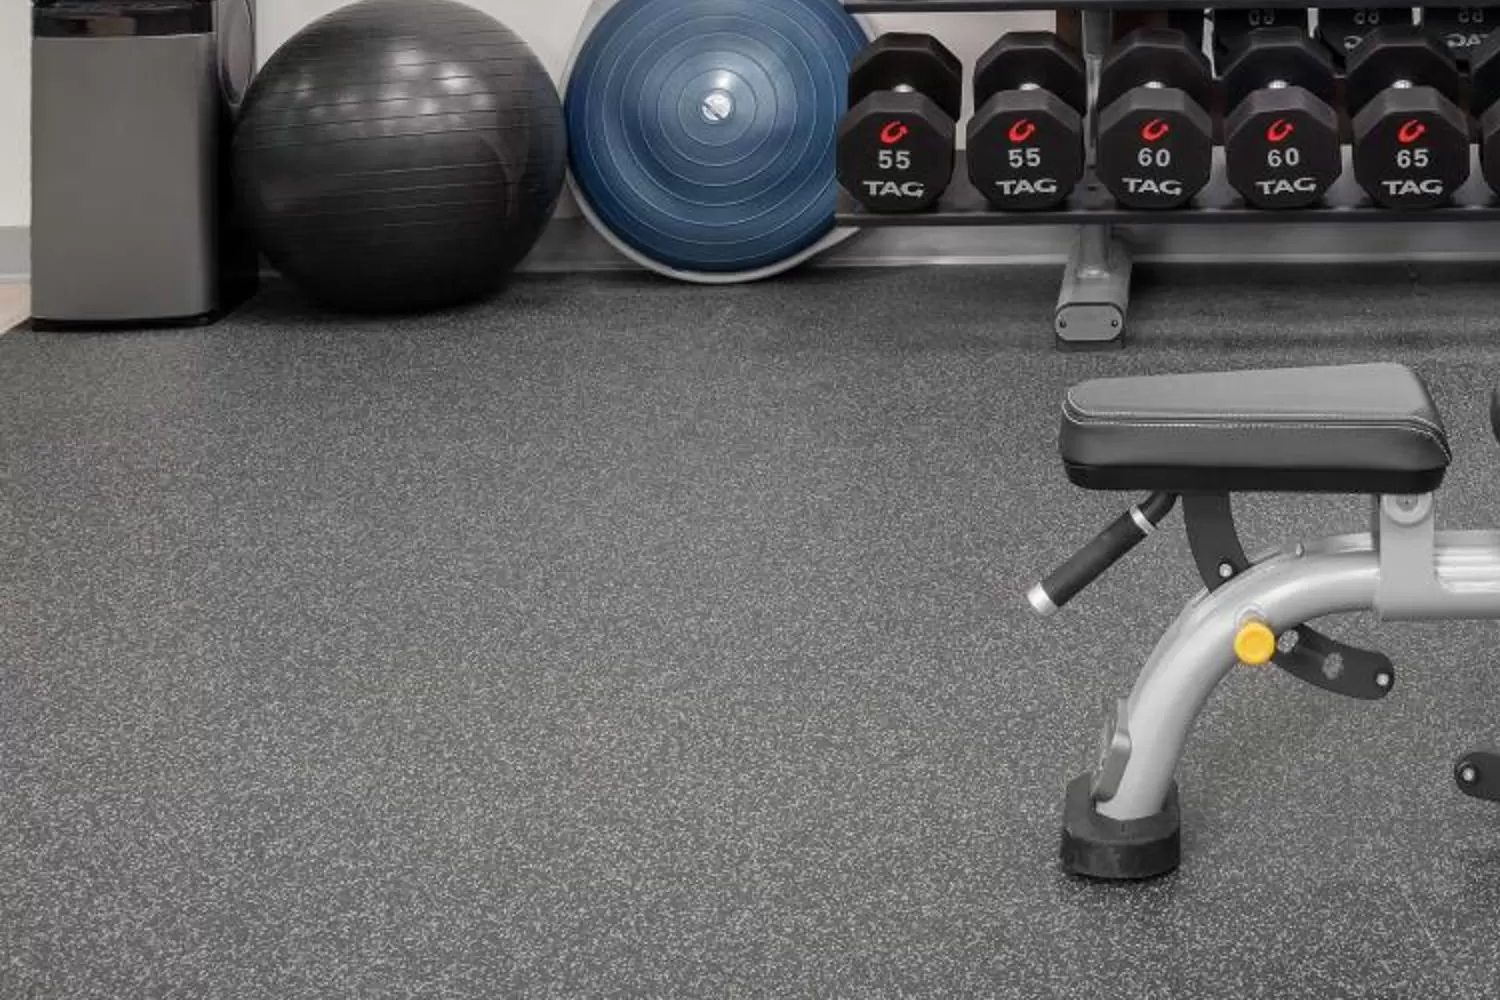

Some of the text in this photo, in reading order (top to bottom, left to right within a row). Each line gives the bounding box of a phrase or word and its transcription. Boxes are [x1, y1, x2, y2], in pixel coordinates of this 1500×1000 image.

[878, 149, 911, 170] 55
[1007, 147, 1041, 169] 55
[1137, 147, 1171, 168] 60
[1267, 147, 1300, 168] 60
[1396, 148, 1429, 169] 65
[862, 180, 925, 198] TAG
[995, 178, 1057, 195] TAG
[1122, 177, 1182, 196] TAG
[1255, 177, 1317, 195] TAG
[1381, 179, 1443, 196] TAG
